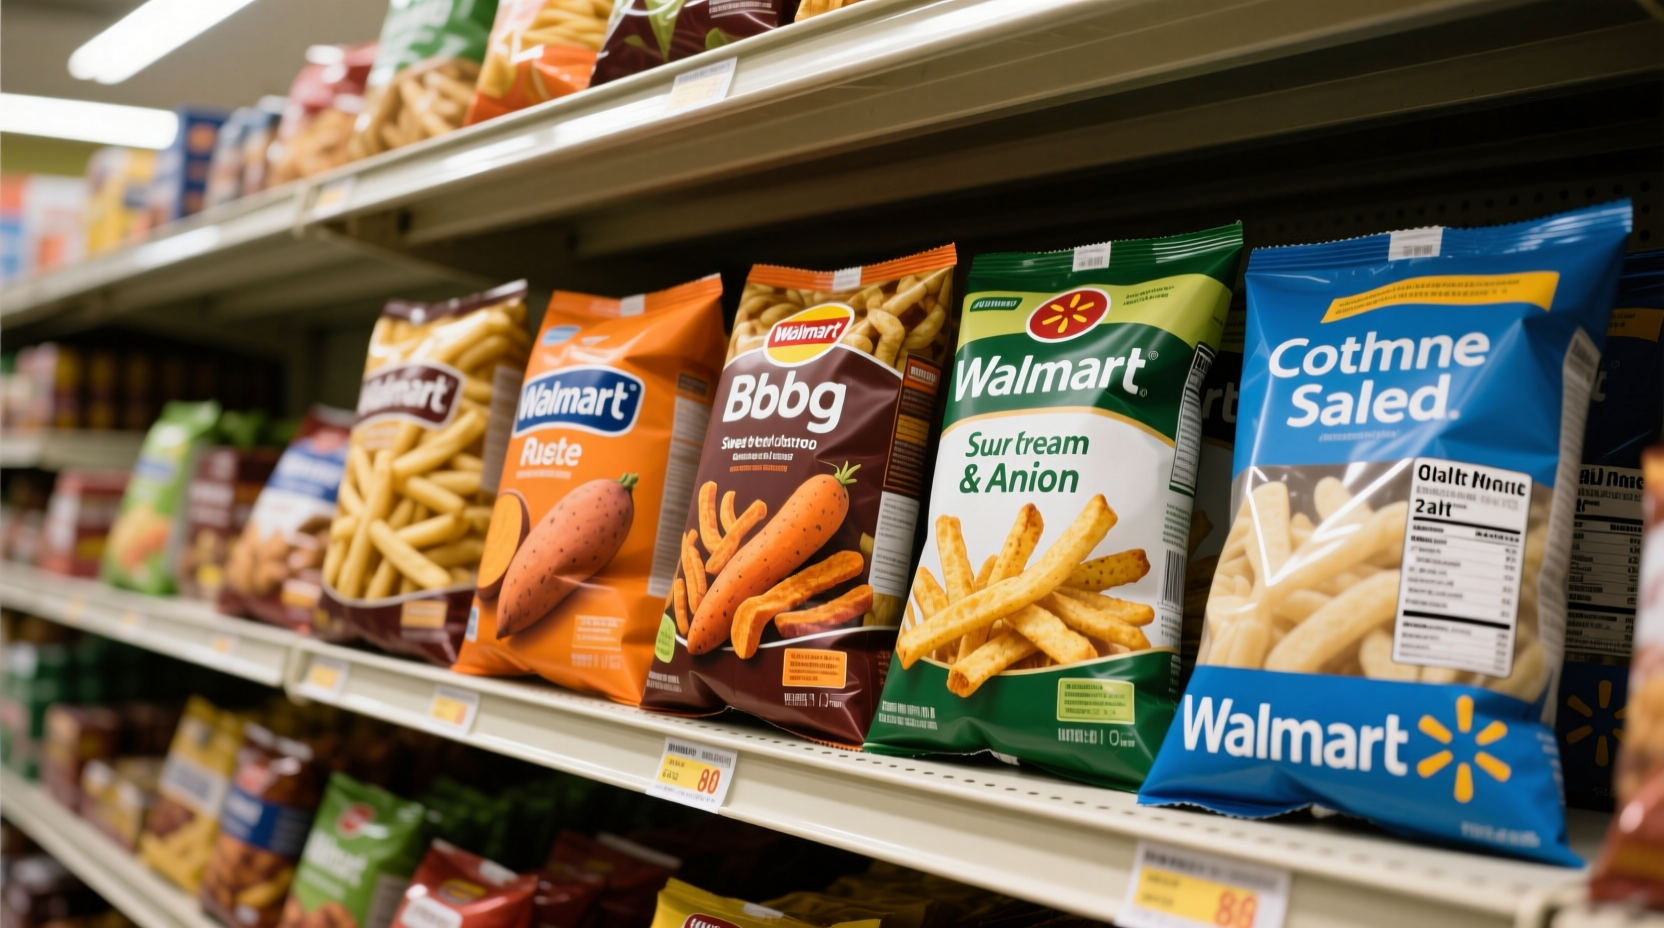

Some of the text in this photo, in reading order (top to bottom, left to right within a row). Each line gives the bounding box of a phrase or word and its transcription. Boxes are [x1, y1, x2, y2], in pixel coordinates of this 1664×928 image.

[774, 321, 842, 343] Walmart
[955, 347, 1146, 402] Walmart
[519, 380, 629, 421] Walmart
[722, 370, 847, 434] Bbbg
[959, 461, 1080, 493] & Anion
[1183, 694, 1409, 776] Walmart
